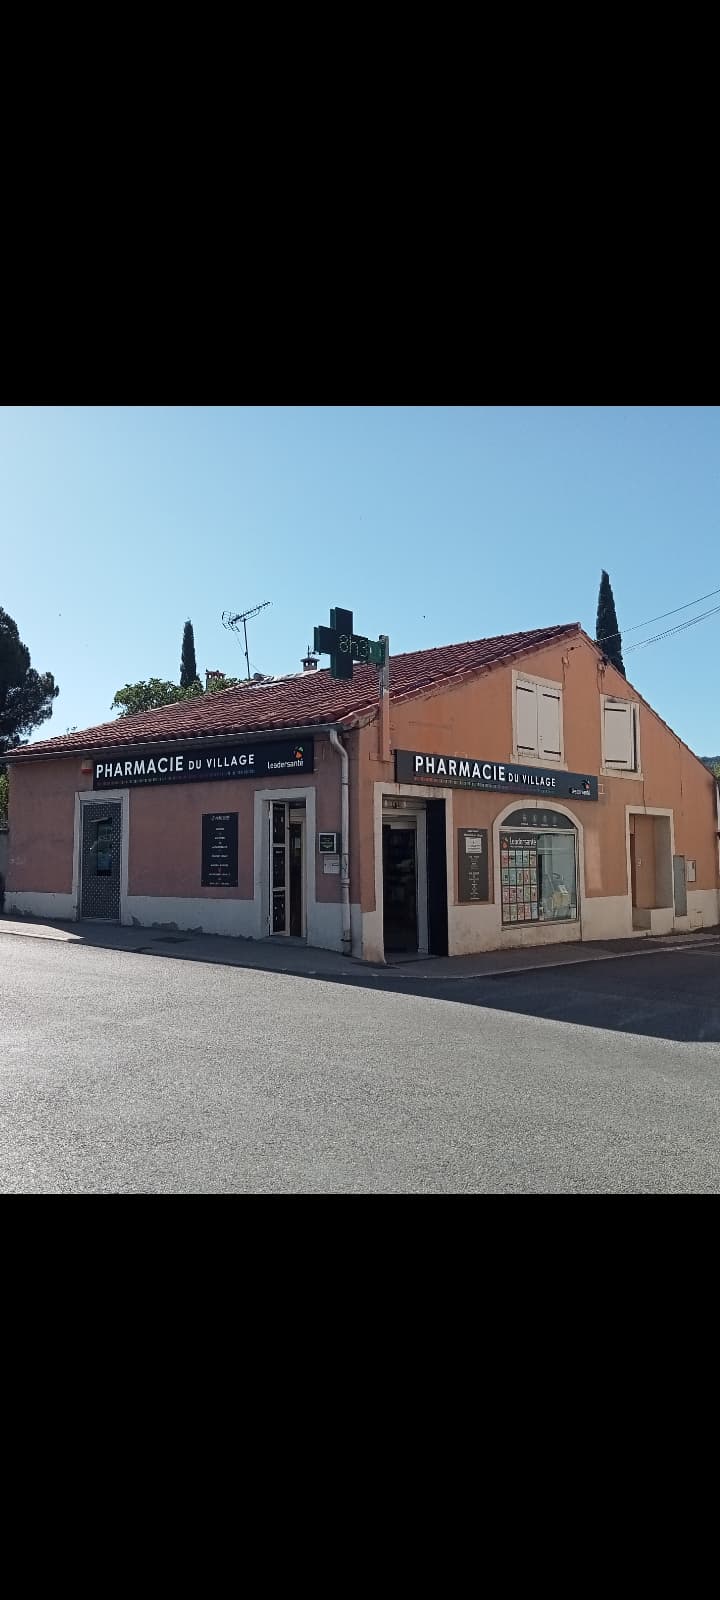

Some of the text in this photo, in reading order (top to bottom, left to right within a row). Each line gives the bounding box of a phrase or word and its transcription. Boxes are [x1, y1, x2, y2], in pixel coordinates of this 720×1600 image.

[96, 755, 184, 779] PHARMACIE
[188, 759, 202, 770] DU
[206, 754, 255, 769] VILLAGE
[415, 755, 506, 781] PHARMACIE
[508, 773, 519, 783] DU
[522, 774, 556, 787] VILLAGE
